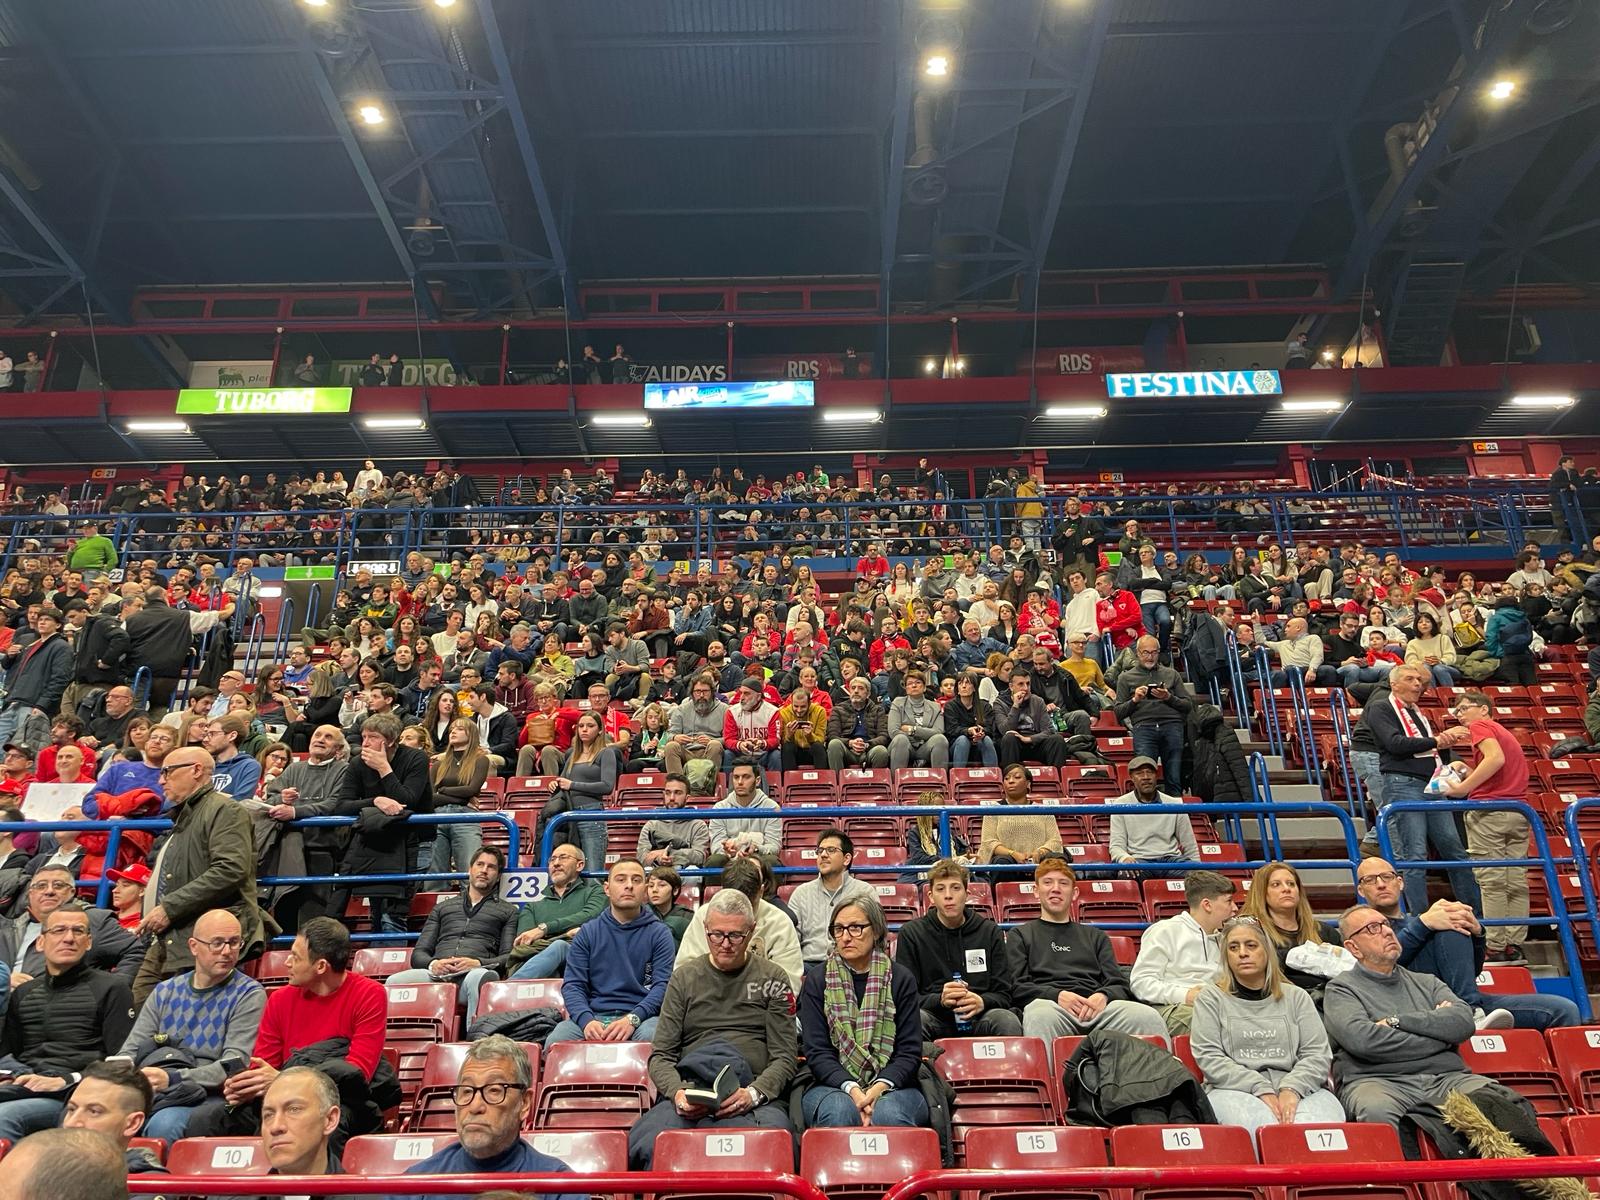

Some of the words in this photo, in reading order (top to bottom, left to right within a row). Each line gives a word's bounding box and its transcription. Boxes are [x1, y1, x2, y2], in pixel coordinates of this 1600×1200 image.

[788, 360, 820, 378] RDS
[1060, 354, 1093, 372] RDS
[339, 363, 457, 387] TORG
[646, 365, 727, 382] ALIDAYS
[1111, 370, 1253, 397] FESTINA
[109, 571, 122, 580] 22
[506, 876, 540, 898] 23
[1099, 883, 1107, 891] 18
[391, 952, 398, 961] 9
[398, 989, 410, 1000] 10
[527, 985, 536, 997] 11
[1243, 1029, 1277, 1041] NOW
[982, 1044, 996, 1056] 15
[1480, 1038, 1495, 1050] 19
[1240, 1047, 1286, 1059] NEVER
[545, 1138, 561, 1154] 12
[717, 1138, 733, 1153] 13
[861, 1137, 877, 1152] 14
[1028, 1135, 1045, 1150] 15
[1172, 1132, 1191, 1147] 16
[1317, 1132, 1333, 1147] 17
[224, 1149, 242, 1165] 10
[408, 1142, 422, 1157] 11
